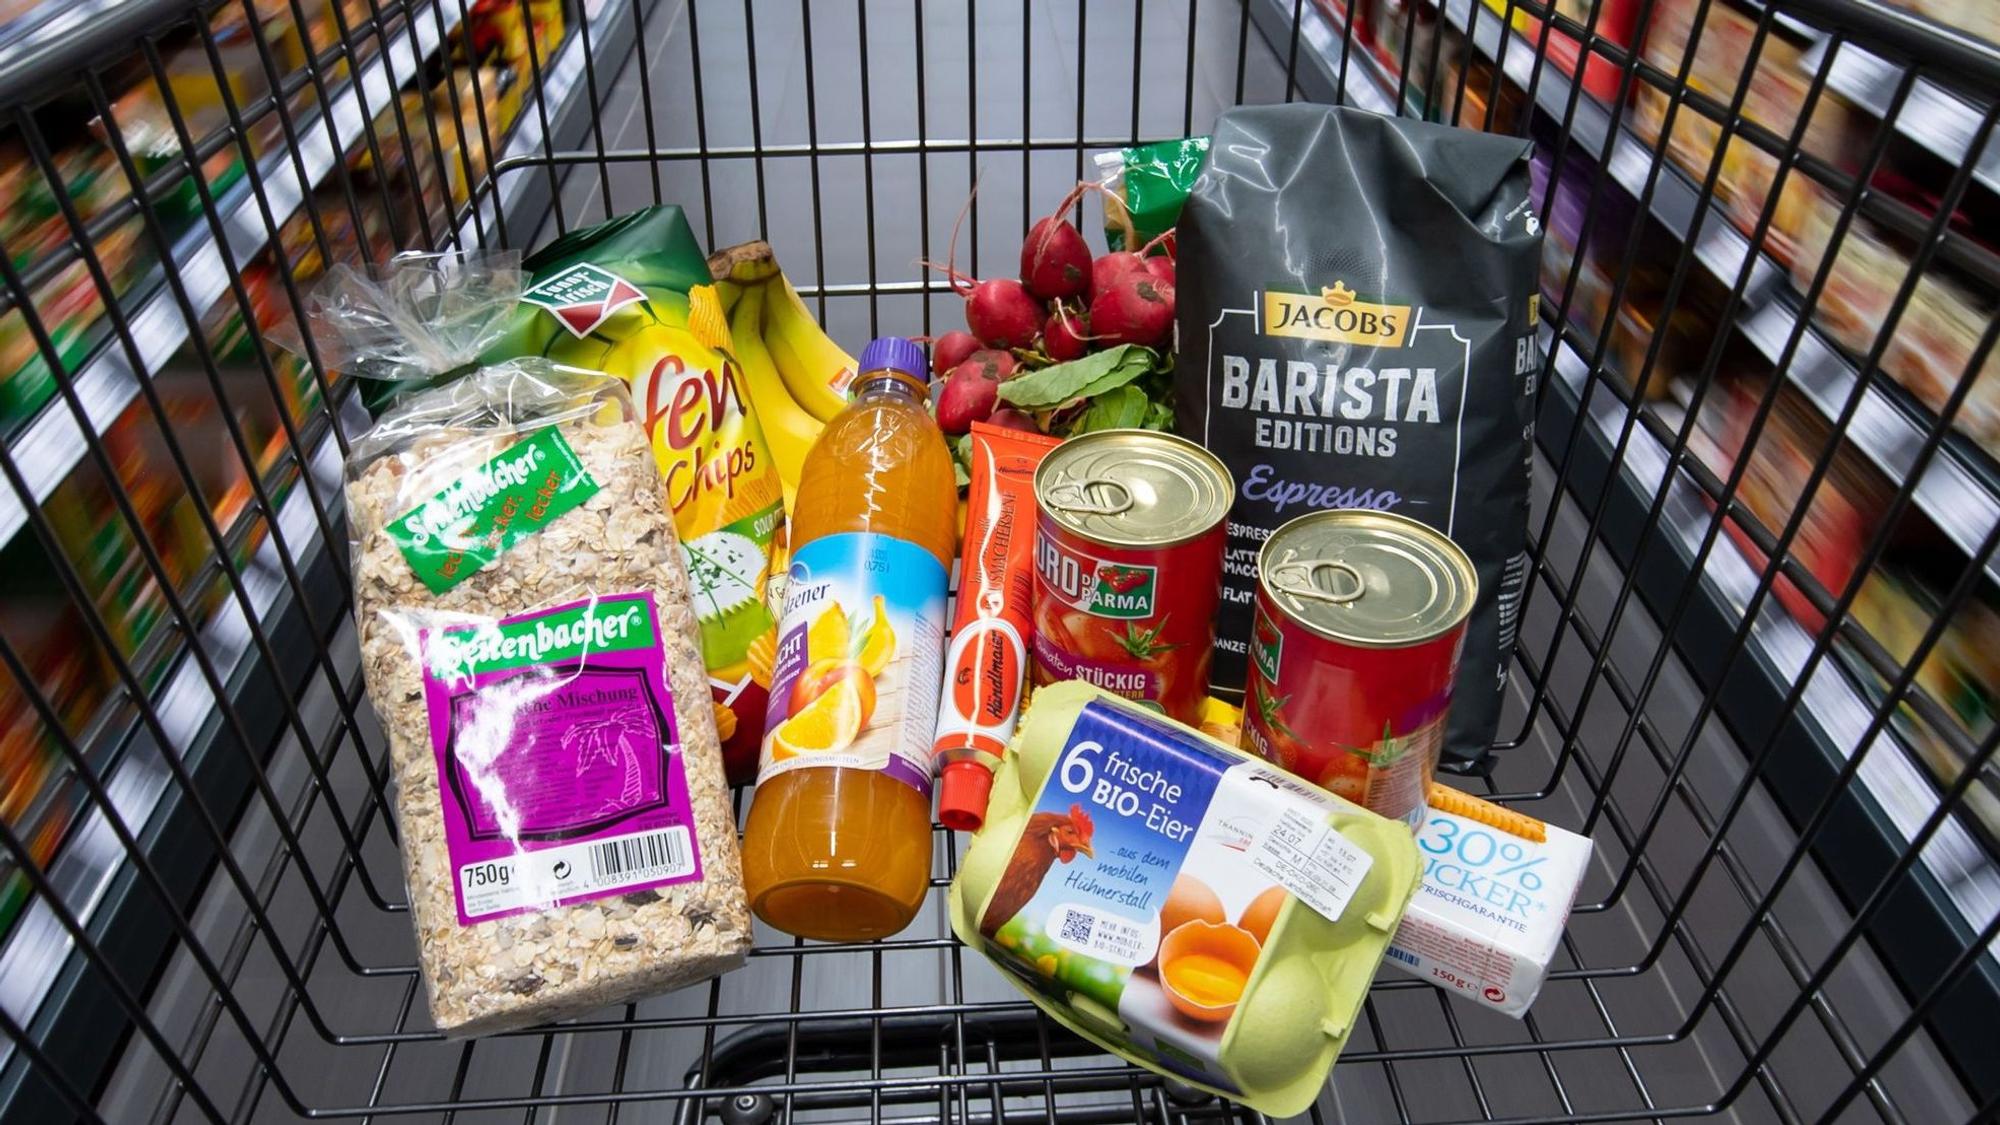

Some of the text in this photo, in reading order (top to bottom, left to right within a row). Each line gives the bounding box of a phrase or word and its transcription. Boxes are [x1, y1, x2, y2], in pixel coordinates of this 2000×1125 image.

[554, 281, 610, 304] frisch
[1272, 302, 1397, 338] JACOBS
[1221, 354, 1441, 424] BARISTA
[1255, 417, 1399, 457] EDITIONS
[526, 469, 562, 522] lecker
[665, 440, 755, 515] Chips
[1241, 463, 1402, 514] Espresso
[1036, 529, 1080, 598] ORO
[1081, 587, 1149, 611] PARMA
[1223, 585, 1252, 604] FLAT
[1075, 664, 1147, 691] STÜCKIG
[557, 688, 638, 708] Mischung
[1060, 740, 1183, 804] 6 frische
[1091, 778, 1194, 843] BIO-Eier
[1097, 862, 1149, 886] mobilen
[1141, 850, 1171, 871] dem
[1419, 818, 1550, 892] 30%
[464, 864, 510, 888] 750g
[1064, 869, 1153, 911] Hühnerstall
[1418, 883, 1528, 934] FRISCHGARANTIE
[1432, 967, 1466, 989] 150 g
